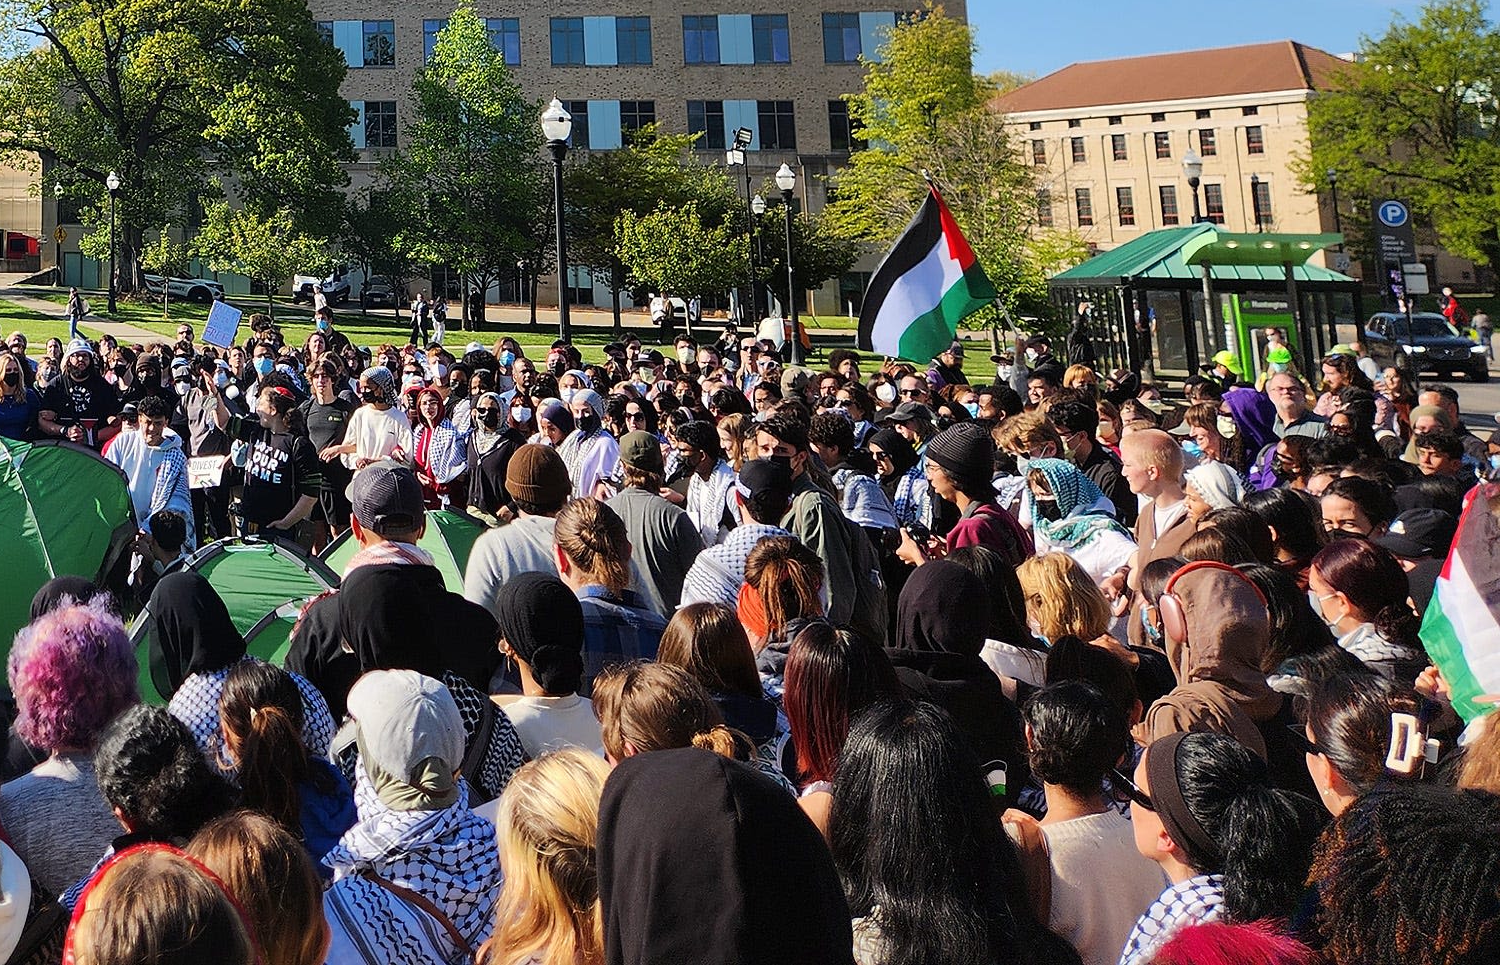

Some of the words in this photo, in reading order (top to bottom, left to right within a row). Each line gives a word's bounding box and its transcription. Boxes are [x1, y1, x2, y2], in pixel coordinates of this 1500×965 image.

[1386, 205, 1402, 222] P
[252, 451, 279, 472] OUR
[274, 448, 289, 463] IN
[192, 459, 218, 471] DIVEST
[245, 460, 283, 484] NAME
